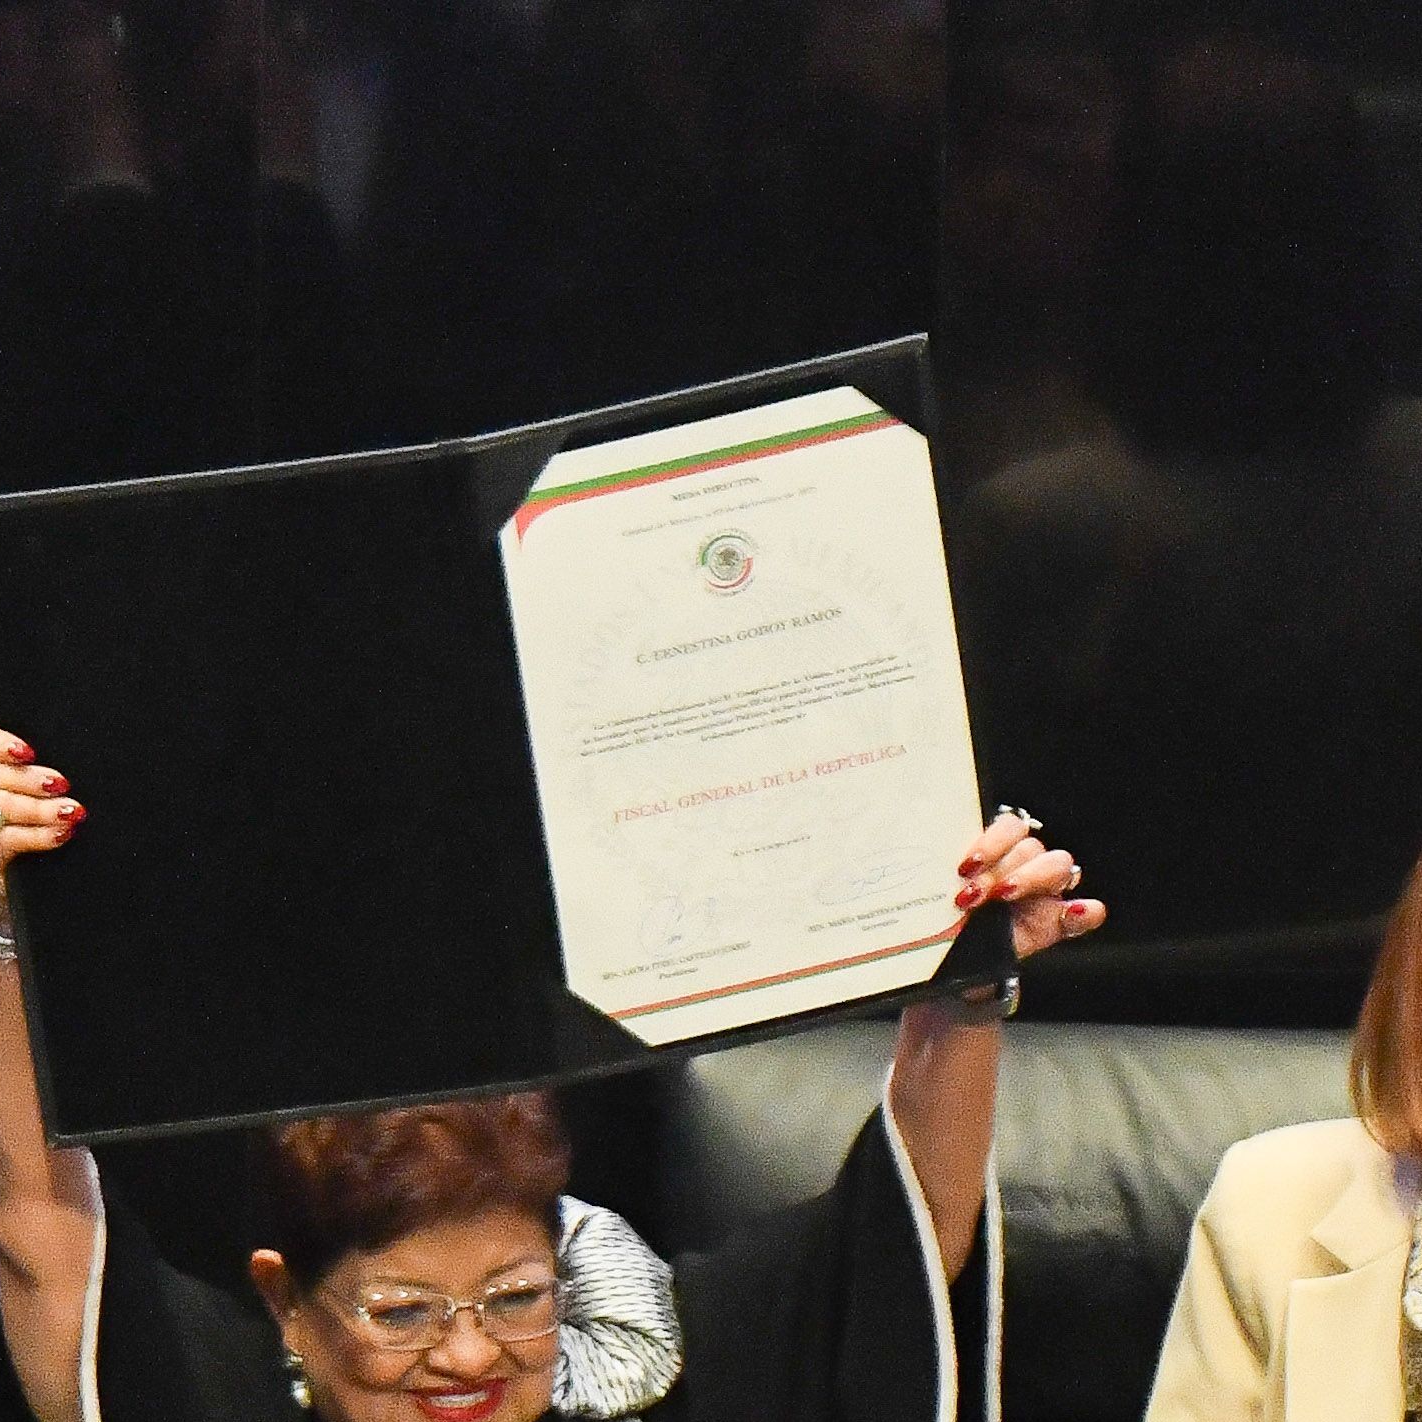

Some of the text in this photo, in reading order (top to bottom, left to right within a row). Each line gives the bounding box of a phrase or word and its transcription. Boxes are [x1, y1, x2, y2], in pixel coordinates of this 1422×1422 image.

[653, 634, 733, 662] ERNESTINA
[791, 607, 842, 628] RAMOS
[612, 800, 674, 824] FISCAL
[678, 781, 759, 809] GENERAL
[761, 773, 785, 789] DE
[788, 769, 810, 783] LA
